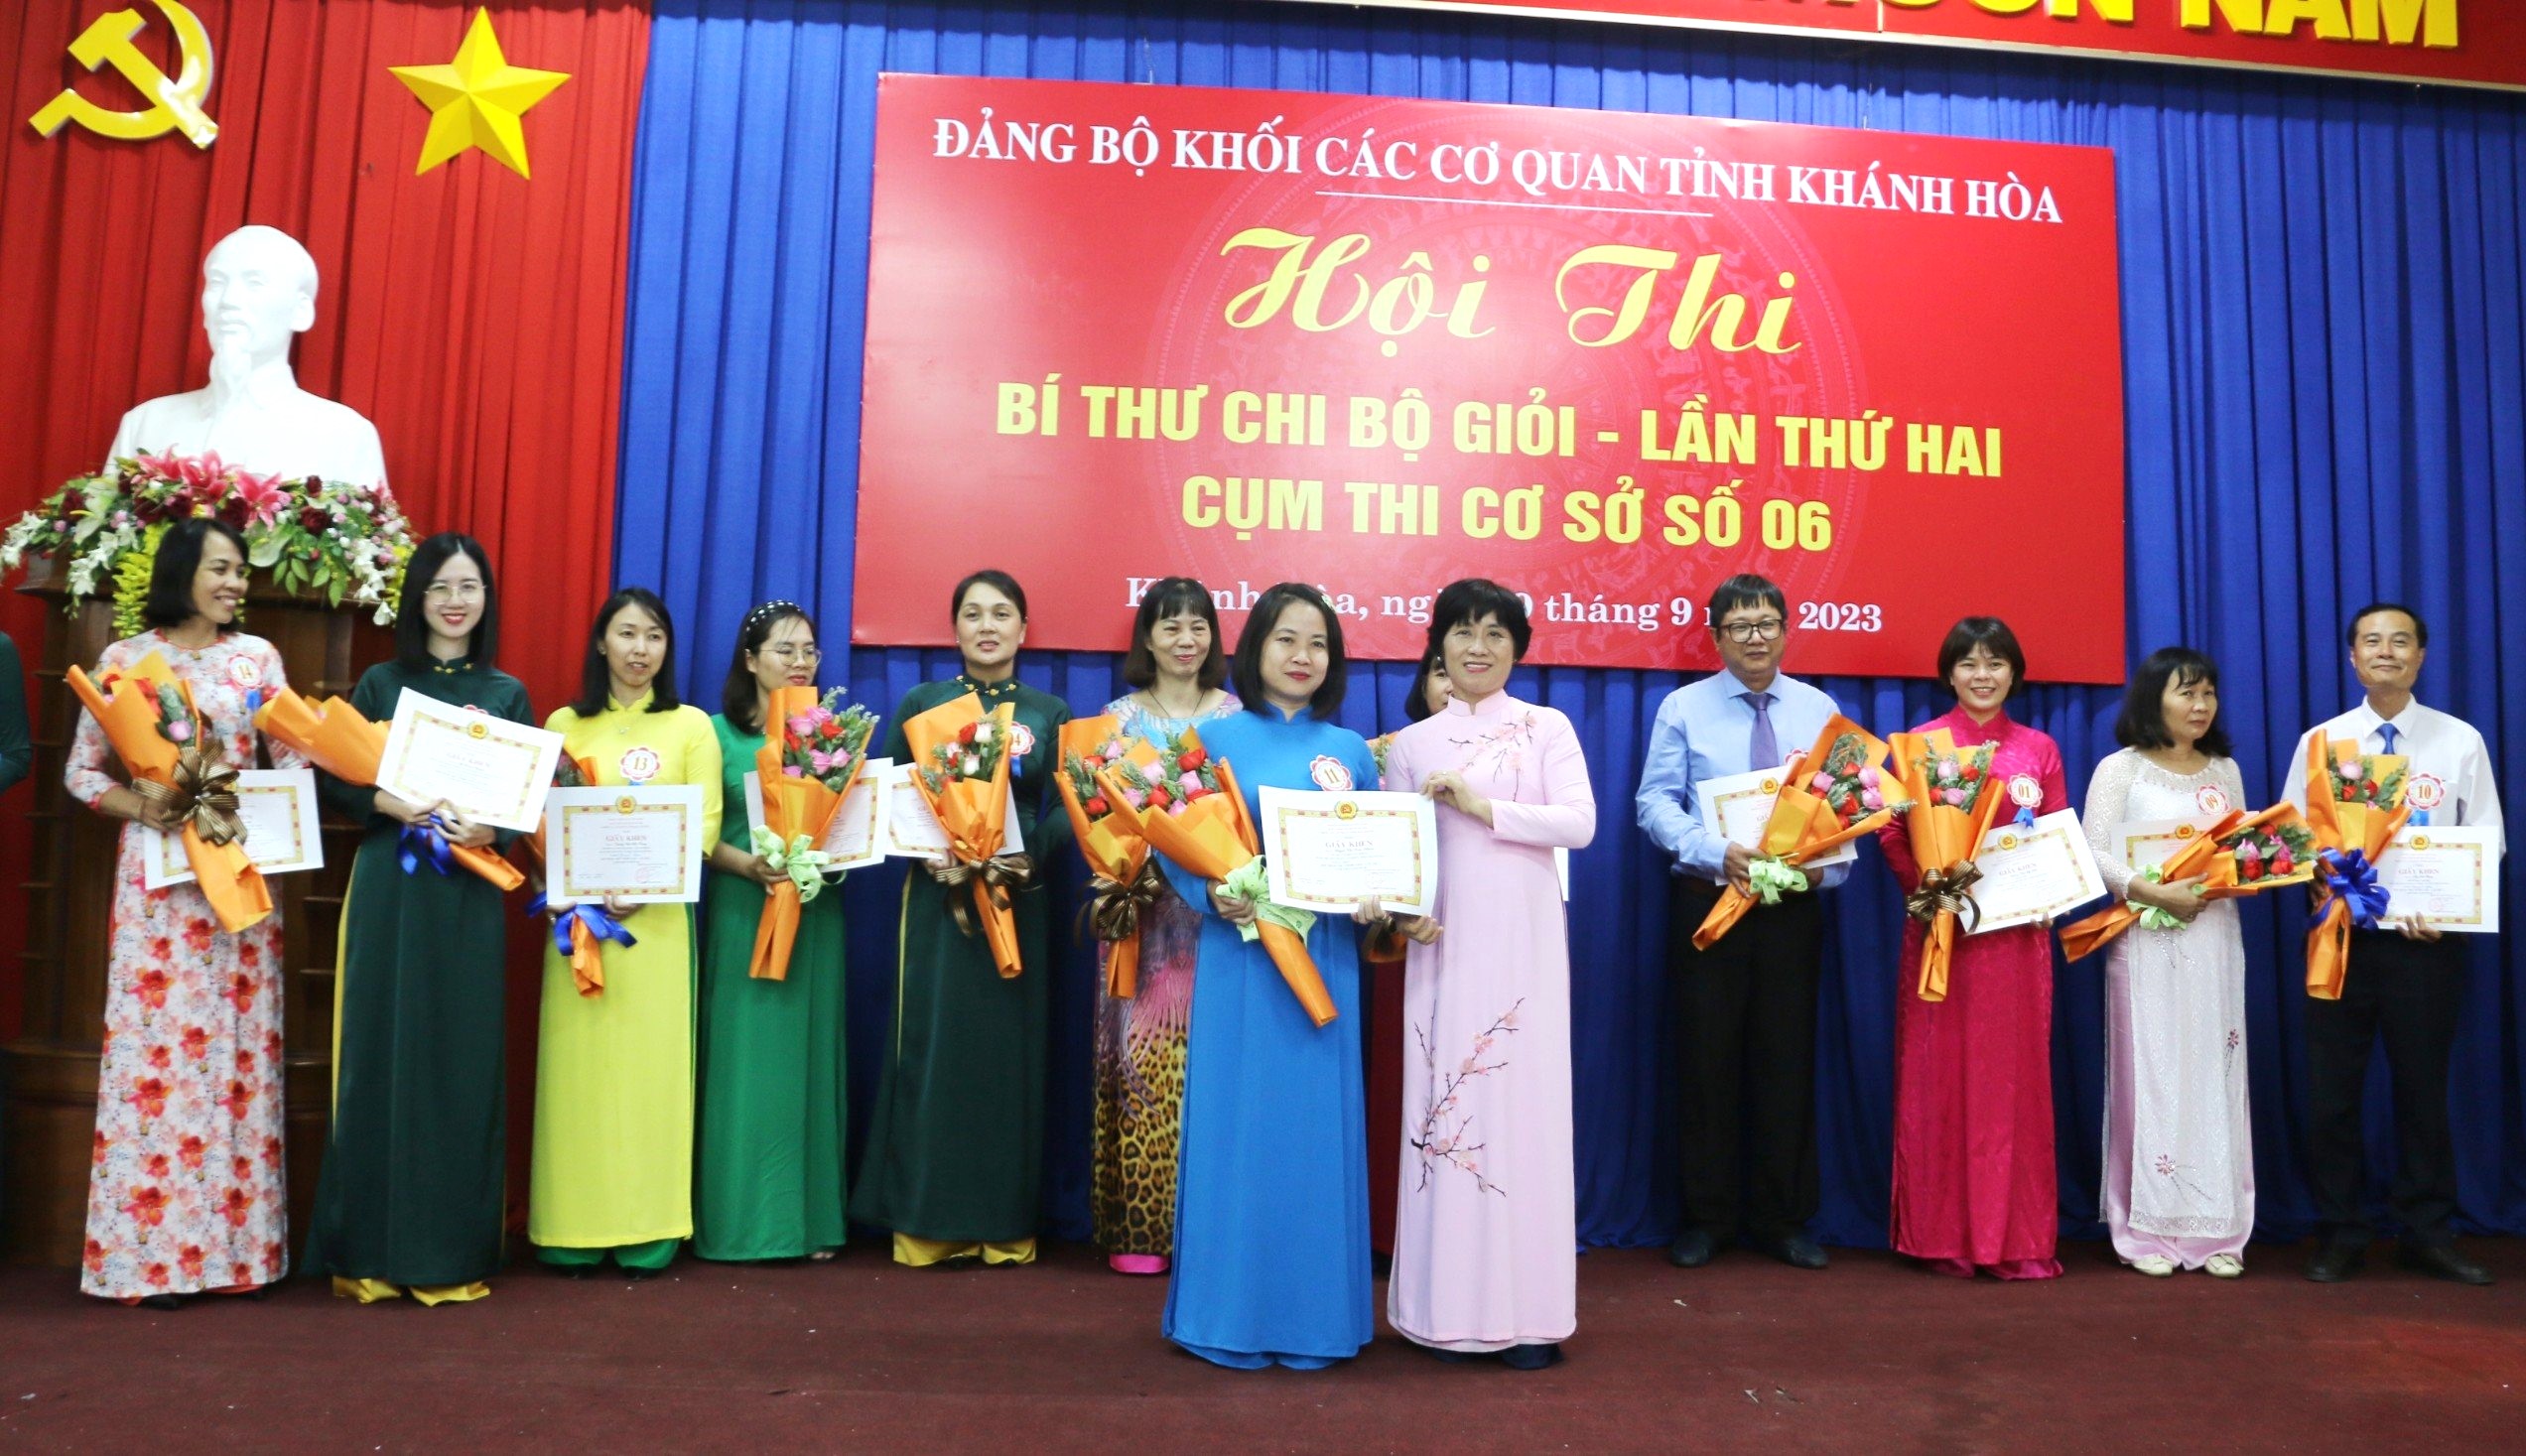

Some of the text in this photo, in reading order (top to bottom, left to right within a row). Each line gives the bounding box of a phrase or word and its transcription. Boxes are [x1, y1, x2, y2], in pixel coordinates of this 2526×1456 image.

[933, 106, 2062, 224] ĐẢNG BỘ KHỐI CÁC CƠ QUAN TỈNH KHÁNH HÒA
[1221, 226, 1802, 358] Hội Thi
[997, 372, 2002, 477] BÍ THƯ CHI BỘ GIỎI - LẦN THỨ HAI
[1181, 474, 1832, 552] CỤM THI CƠ SỞ SỐ 06
[1126, 577, 1262, 611] Knh
[1543, 592, 1662, 631] tháng
[1669, 596, 1692, 626] 9
[1797, 601, 1883, 633] 2023
[633, 757, 648, 771] 13
[2018, 784, 2030, 798] 01
[2418, 784, 2433, 799] 10
